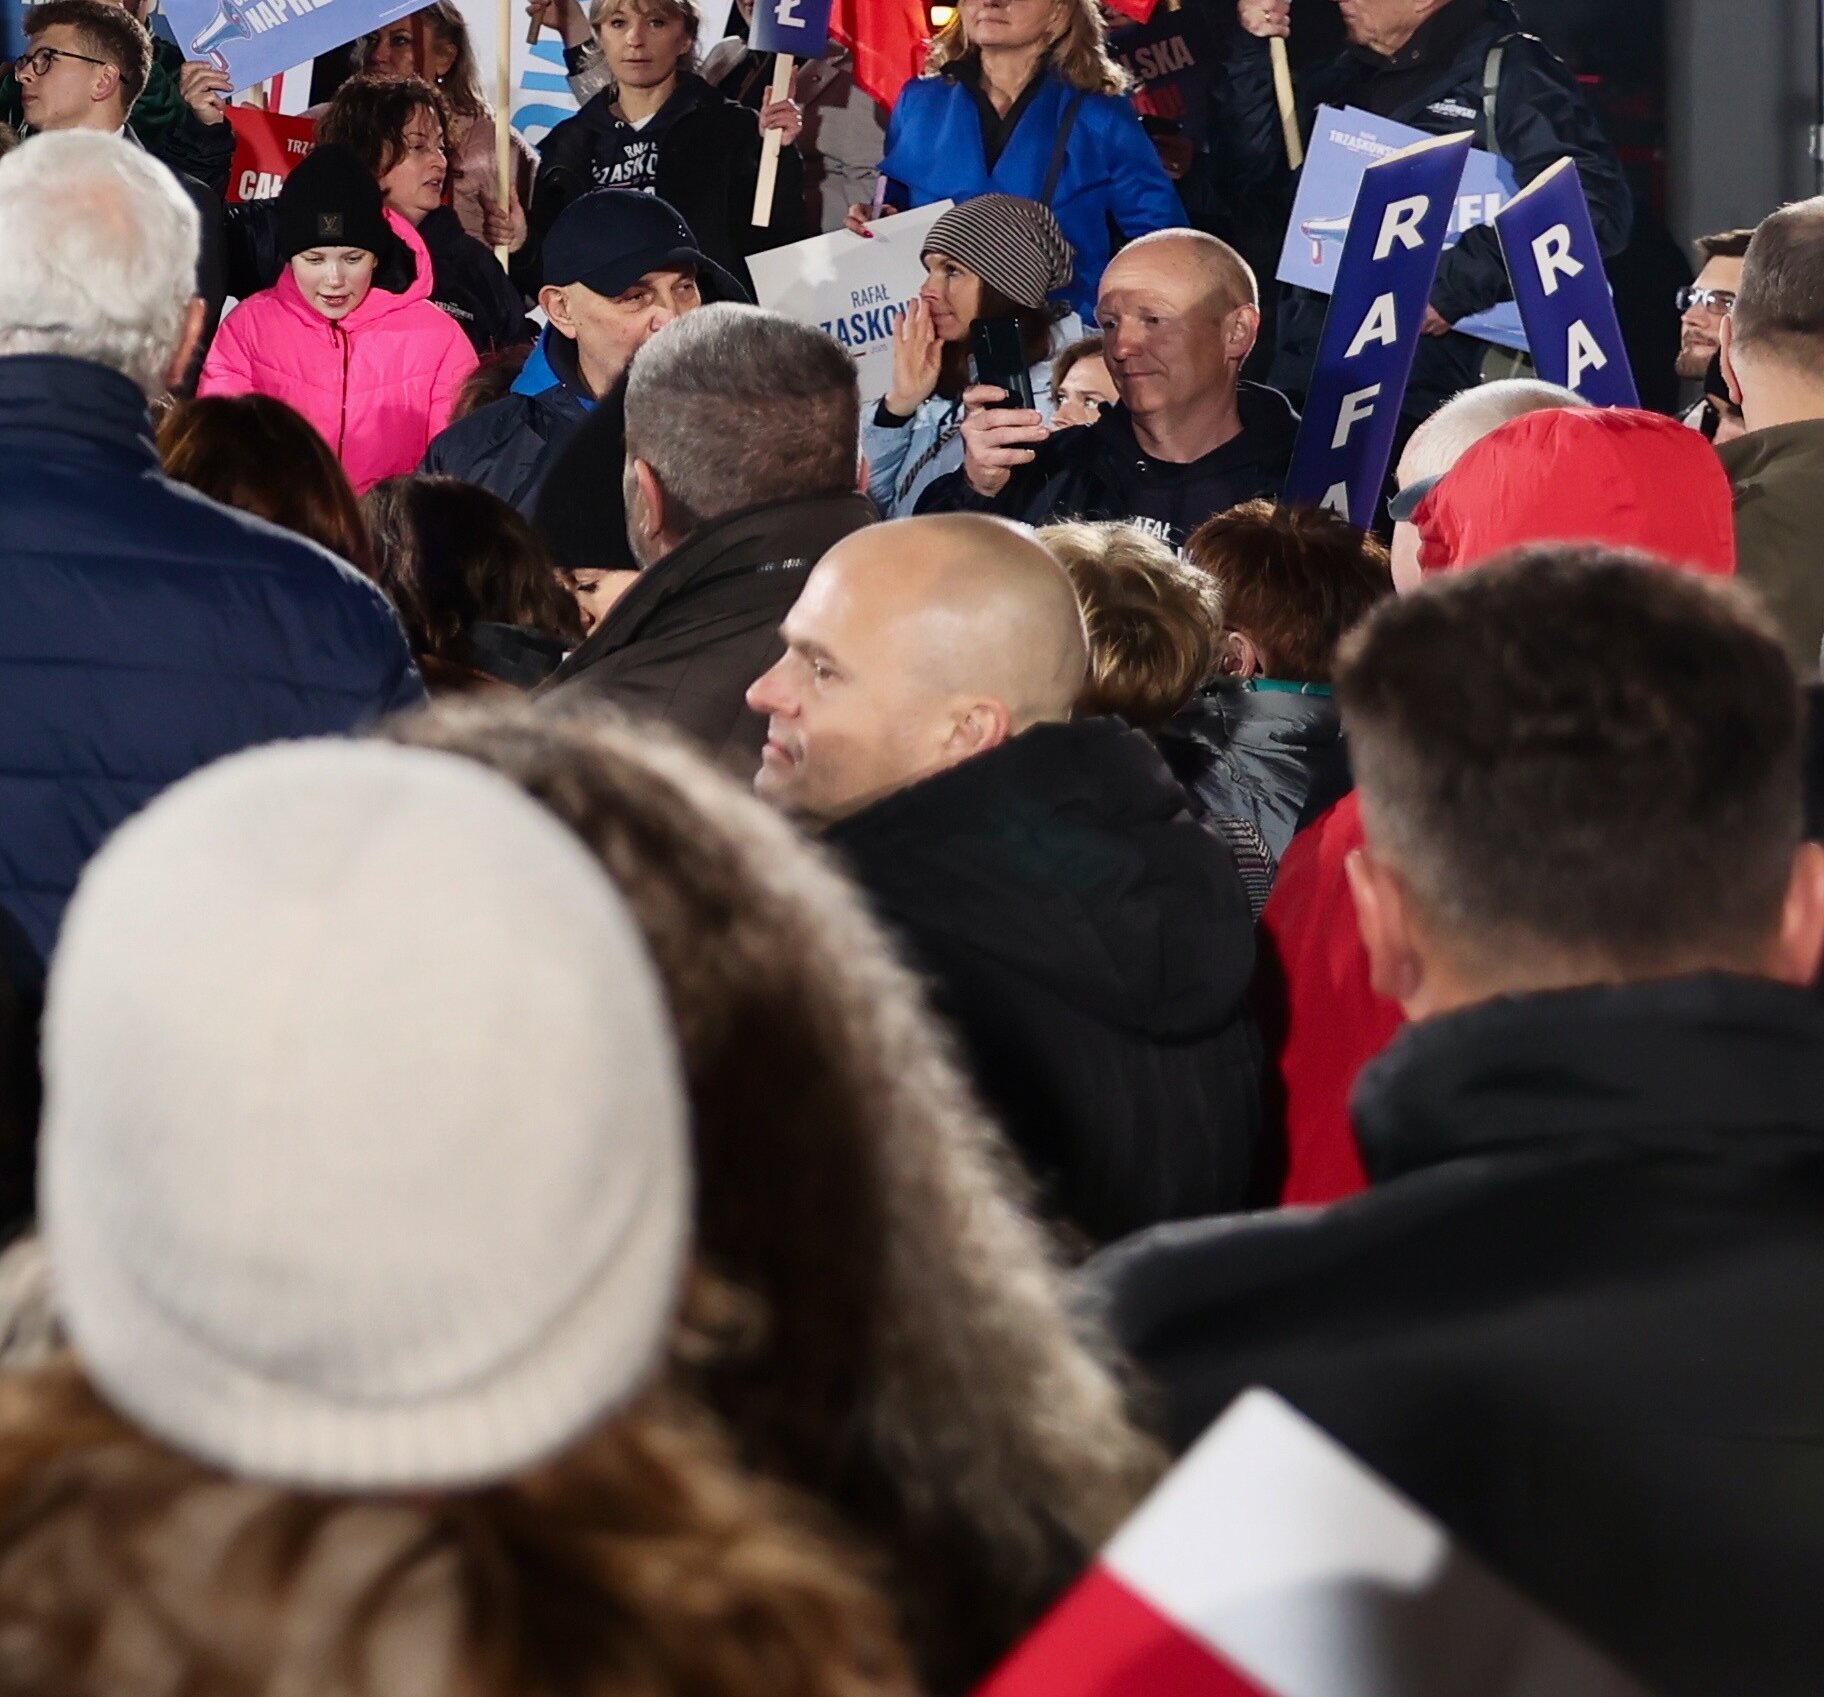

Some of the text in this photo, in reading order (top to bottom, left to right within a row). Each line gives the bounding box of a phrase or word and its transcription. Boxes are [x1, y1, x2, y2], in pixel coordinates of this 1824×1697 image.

[851, 284, 891, 309] RAFAŁ
[1319, 195, 1430, 523] RAFA
[1134, 515, 1171, 542] AFAŁ
